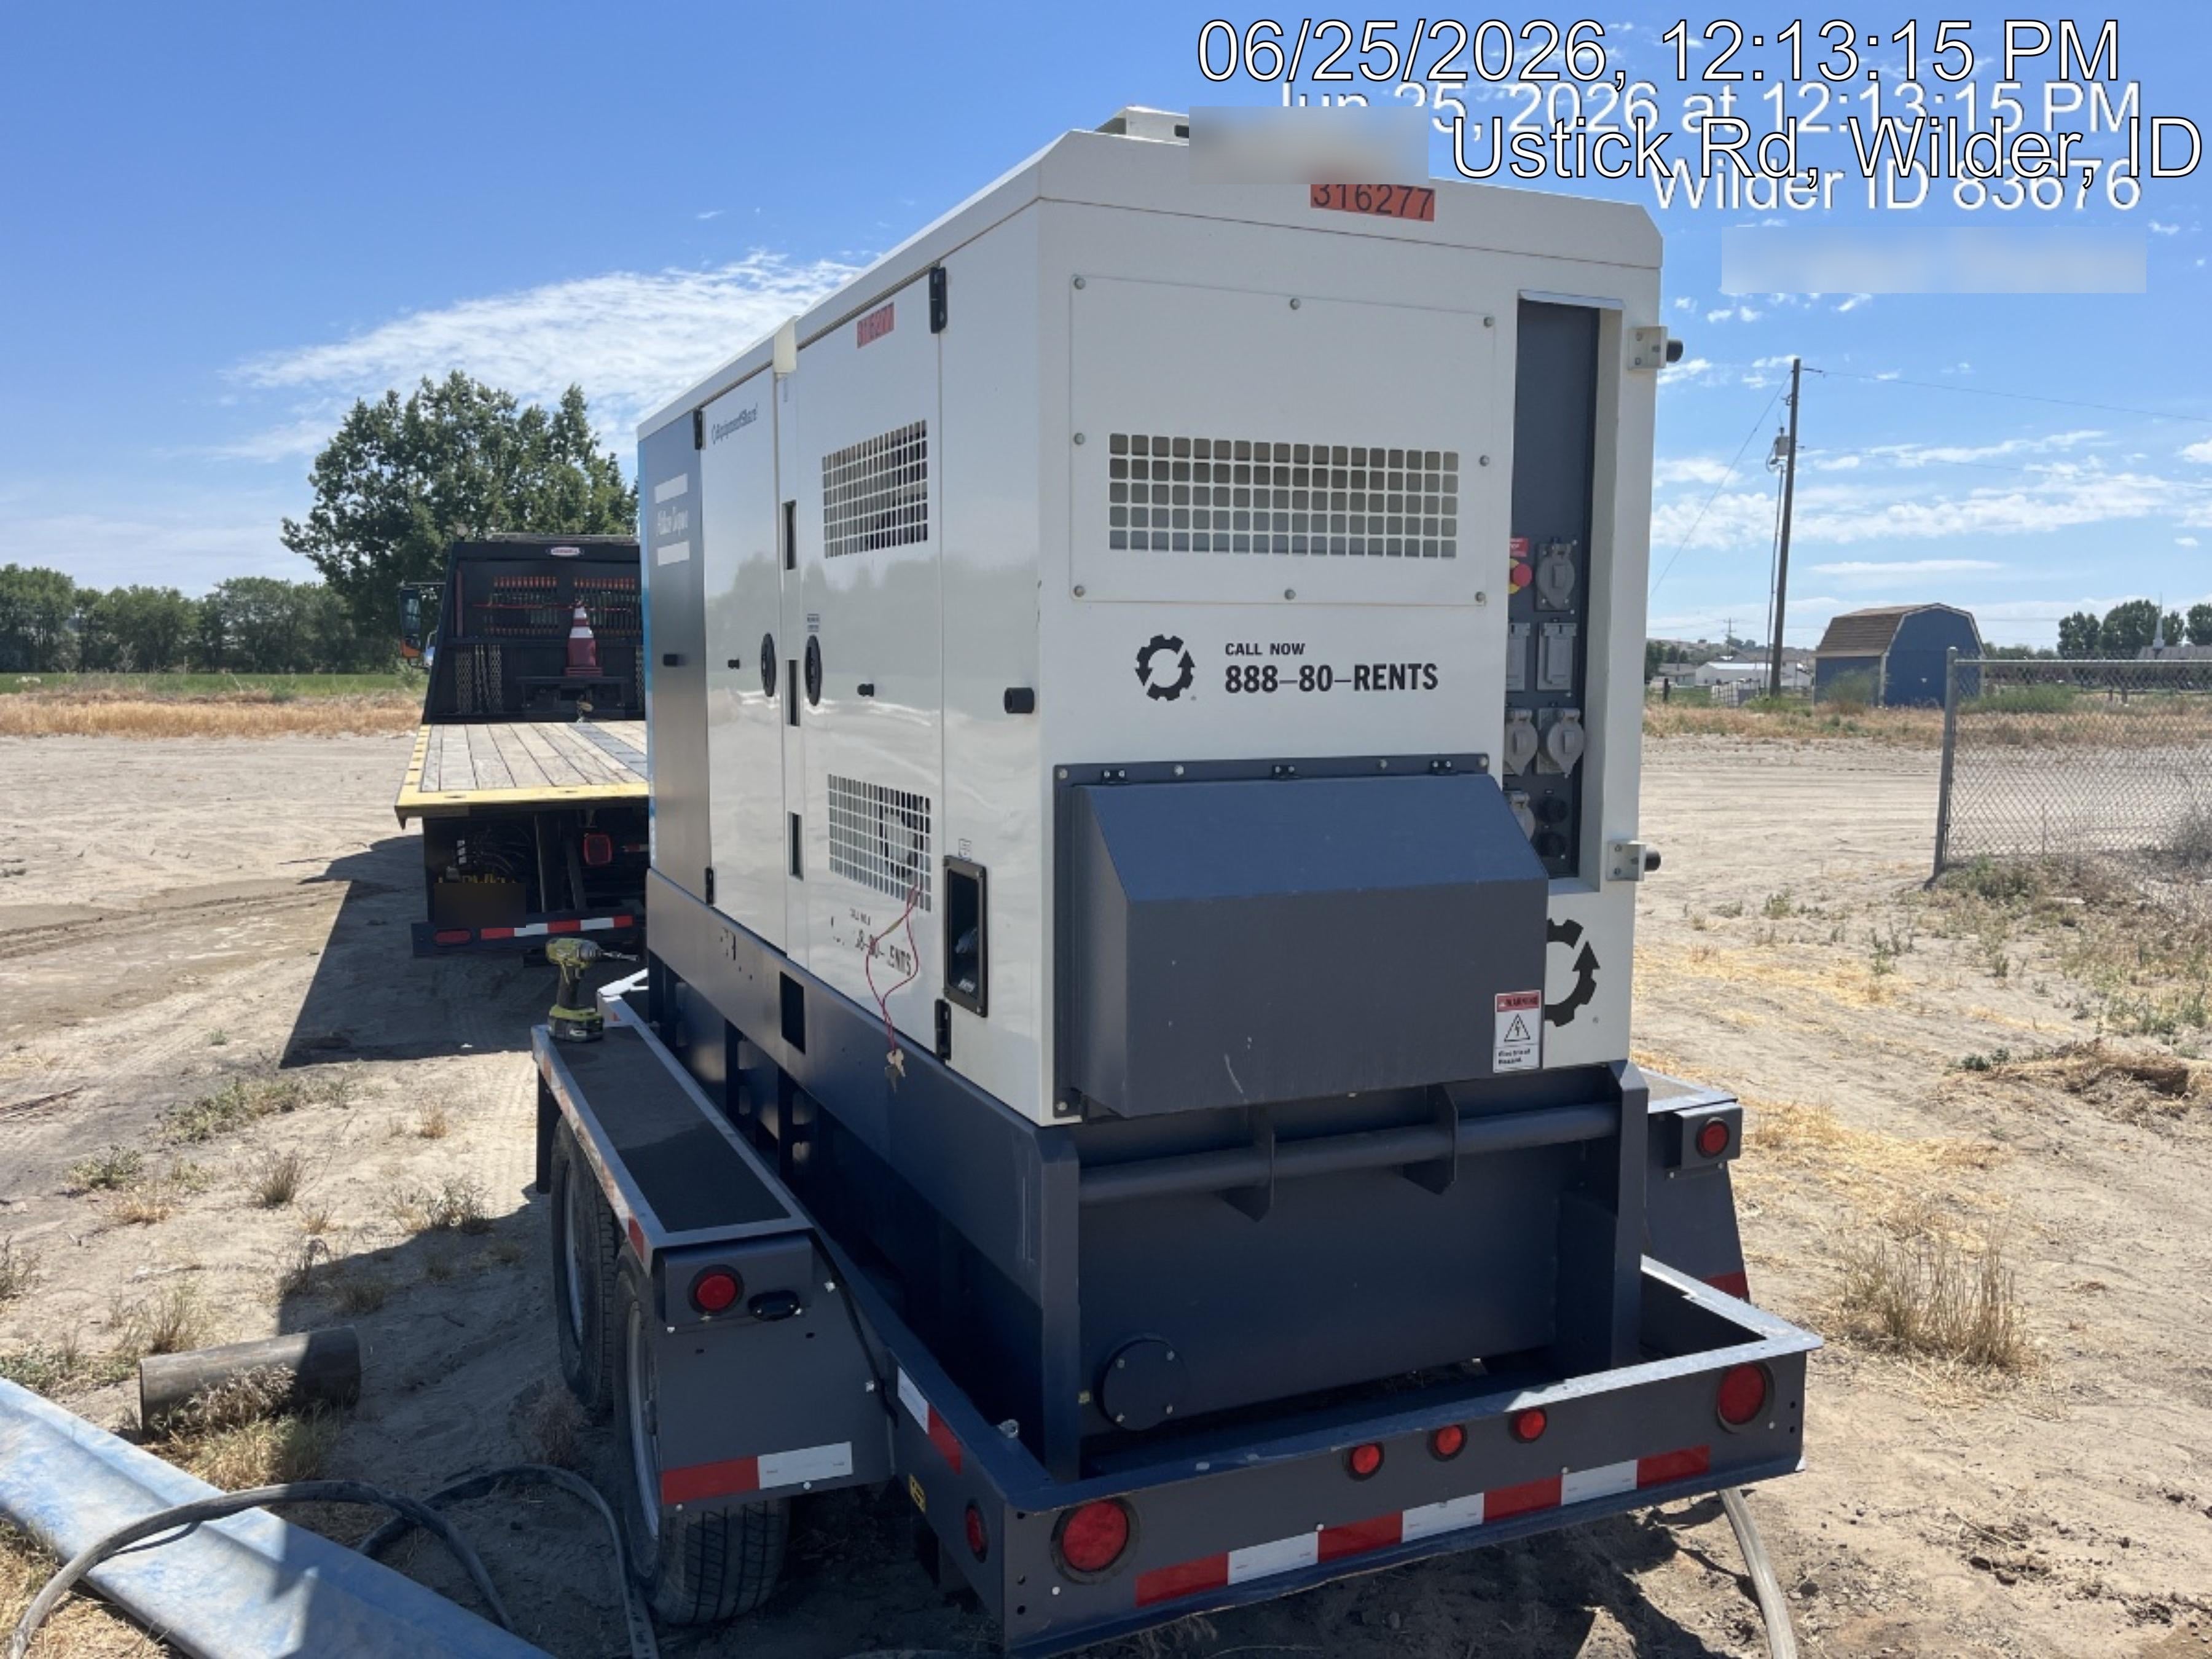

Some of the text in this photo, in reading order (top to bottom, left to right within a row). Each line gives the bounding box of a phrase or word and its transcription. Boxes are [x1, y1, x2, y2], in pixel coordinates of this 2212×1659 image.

[1313, 184, 1434, 218] 316277
[1225, 643, 1306, 656] CALL NOW
